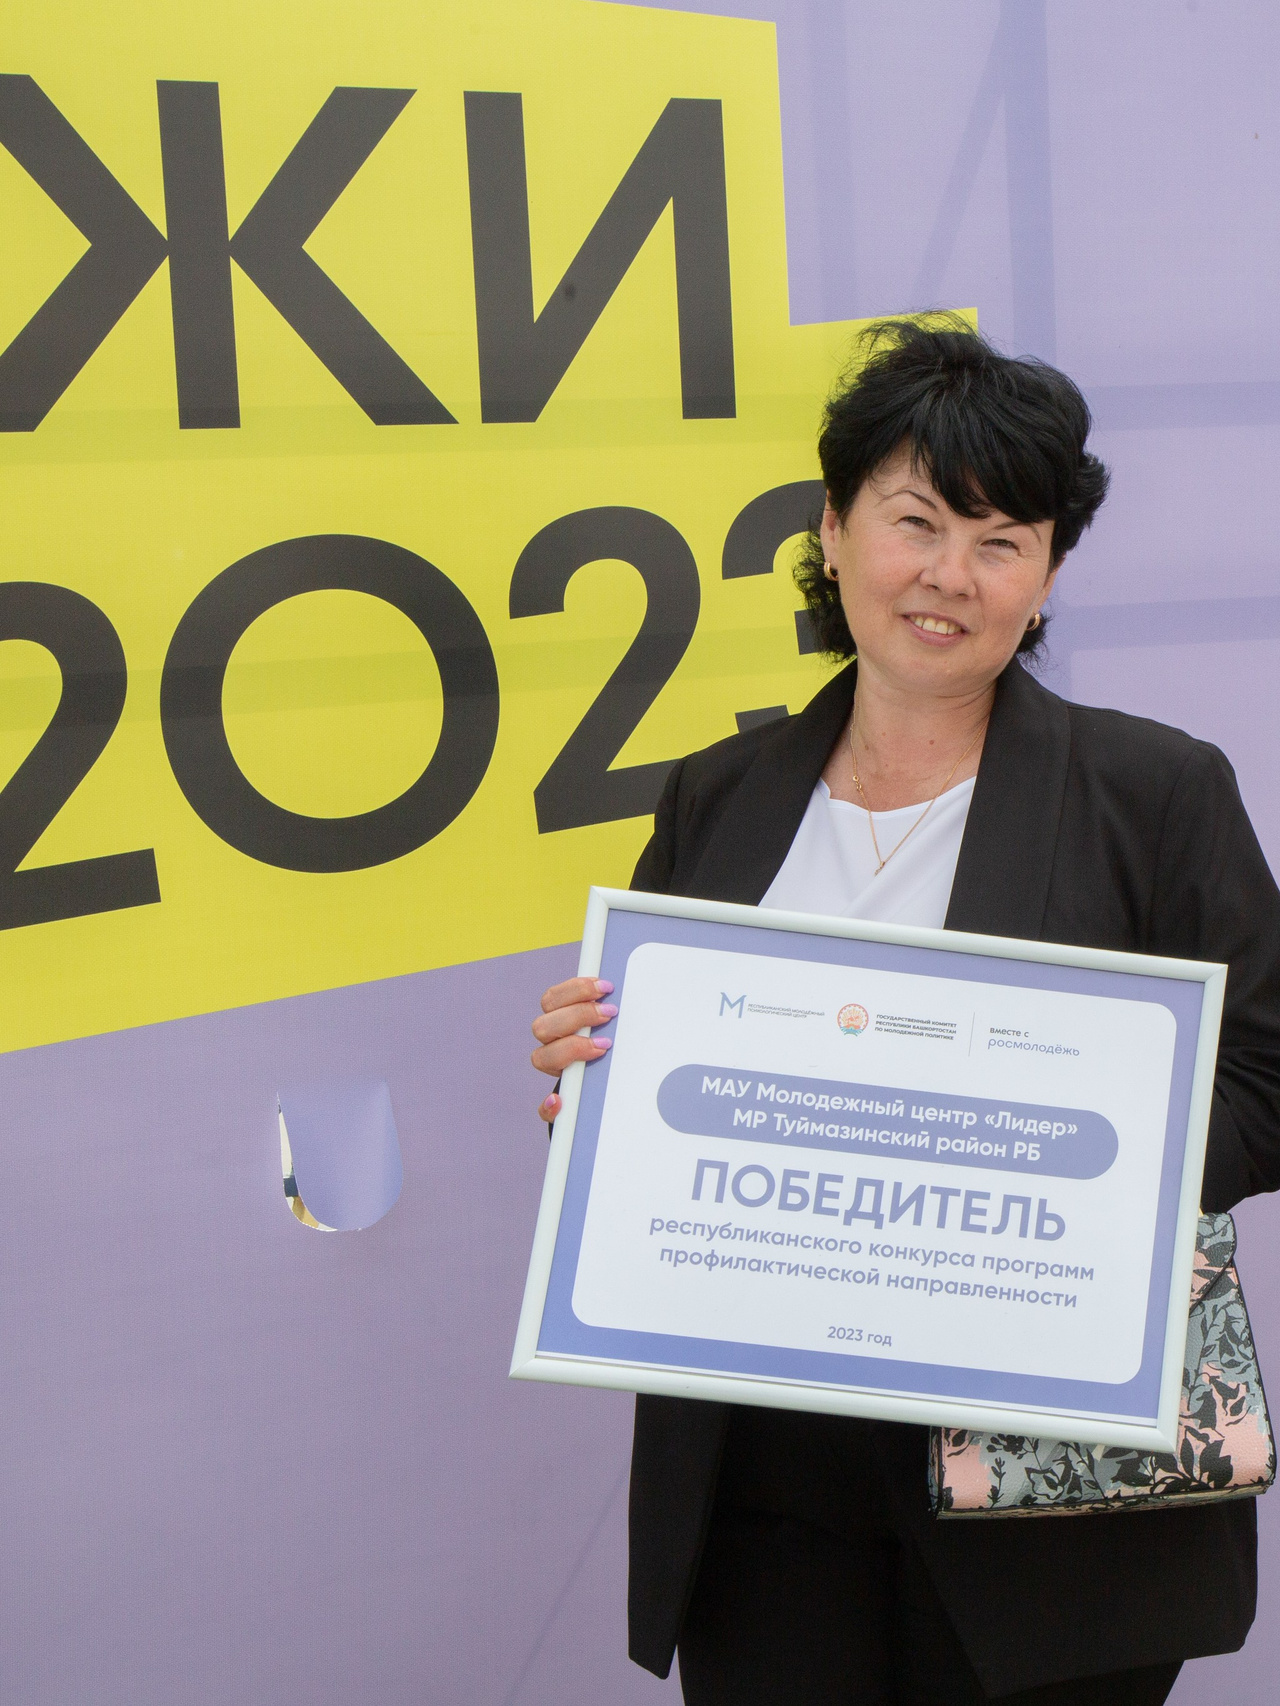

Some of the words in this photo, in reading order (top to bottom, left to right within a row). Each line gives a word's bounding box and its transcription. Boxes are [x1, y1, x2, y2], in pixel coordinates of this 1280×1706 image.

[875, 1020, 911, 1029] РЕСПУБЛИКИ
[912, 1025, 957, 1034] БАШКОРТОСТАН
[876, 1014, 931, 1025] ГОСУДАРСТВЕННЫЙ
[924, 1032, 954, 1040] ПОЛИТИКЕ
[989, 1027, 1021, 1037] вместе
[987, 1038, 1080, 1057] росмолодёжь
[701, 1075, 751, 1098] МАУ
[756, 1082, 905, 1117] Молодежный
[911, 1105, 978, 1129] центр
[984, 1111, 1079, 1140] «Лидер»
[732, 1108, 767, 1129] МР
[773, 1112, 931, 1149] Туймазинский
[936, 1137, 1007, 1158] район
[1013, 1141, 1041, 1161] РБ
[691, 1159, 1066, 1241] ПОБЕДИТЕЛЬ
[649, 1216, 862, 1256] республиканского
[869, 1240, 976, 1269] конкурса
[982, 1253, 1095, 1284] программ
[659, 1249, 880, 1287] профилактической
[886, 1274, 1078, 1308] направленности
[827, 1326, 864, 1341] 2023
[867, 1333, 892, 1347] год
